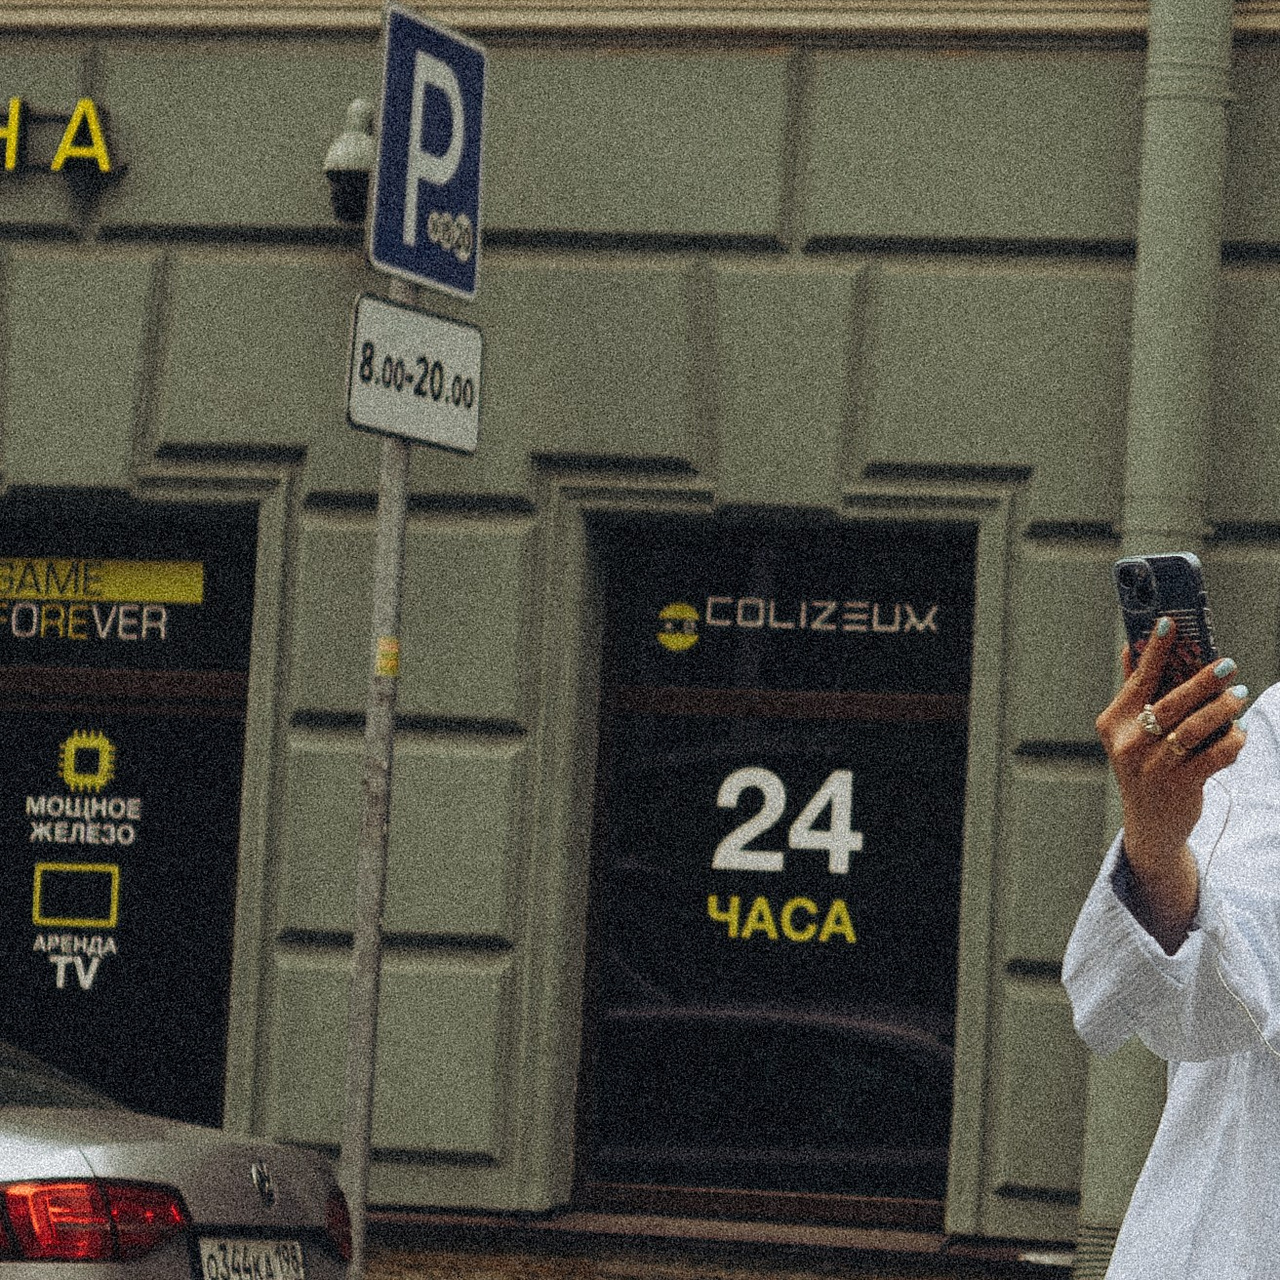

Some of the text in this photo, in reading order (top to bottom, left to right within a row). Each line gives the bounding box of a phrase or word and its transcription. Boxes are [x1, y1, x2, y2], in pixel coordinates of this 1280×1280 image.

[402, 51, 465, 247] P
[359, 341, 475, 409] 8.00-20.00
[706, 596, 940, 633] COLIZEUM
[25, 796, 141, 821] МОЩНОЕ
[711, 766, 864, 875] 24
[29, 821, 135, 846] ЖЕЛЕЗО
[707, 894, 857, 943] ЧАСА
[32, 933, 117, 959] АРЕНДА
[49, 955, 100, 990] TV
